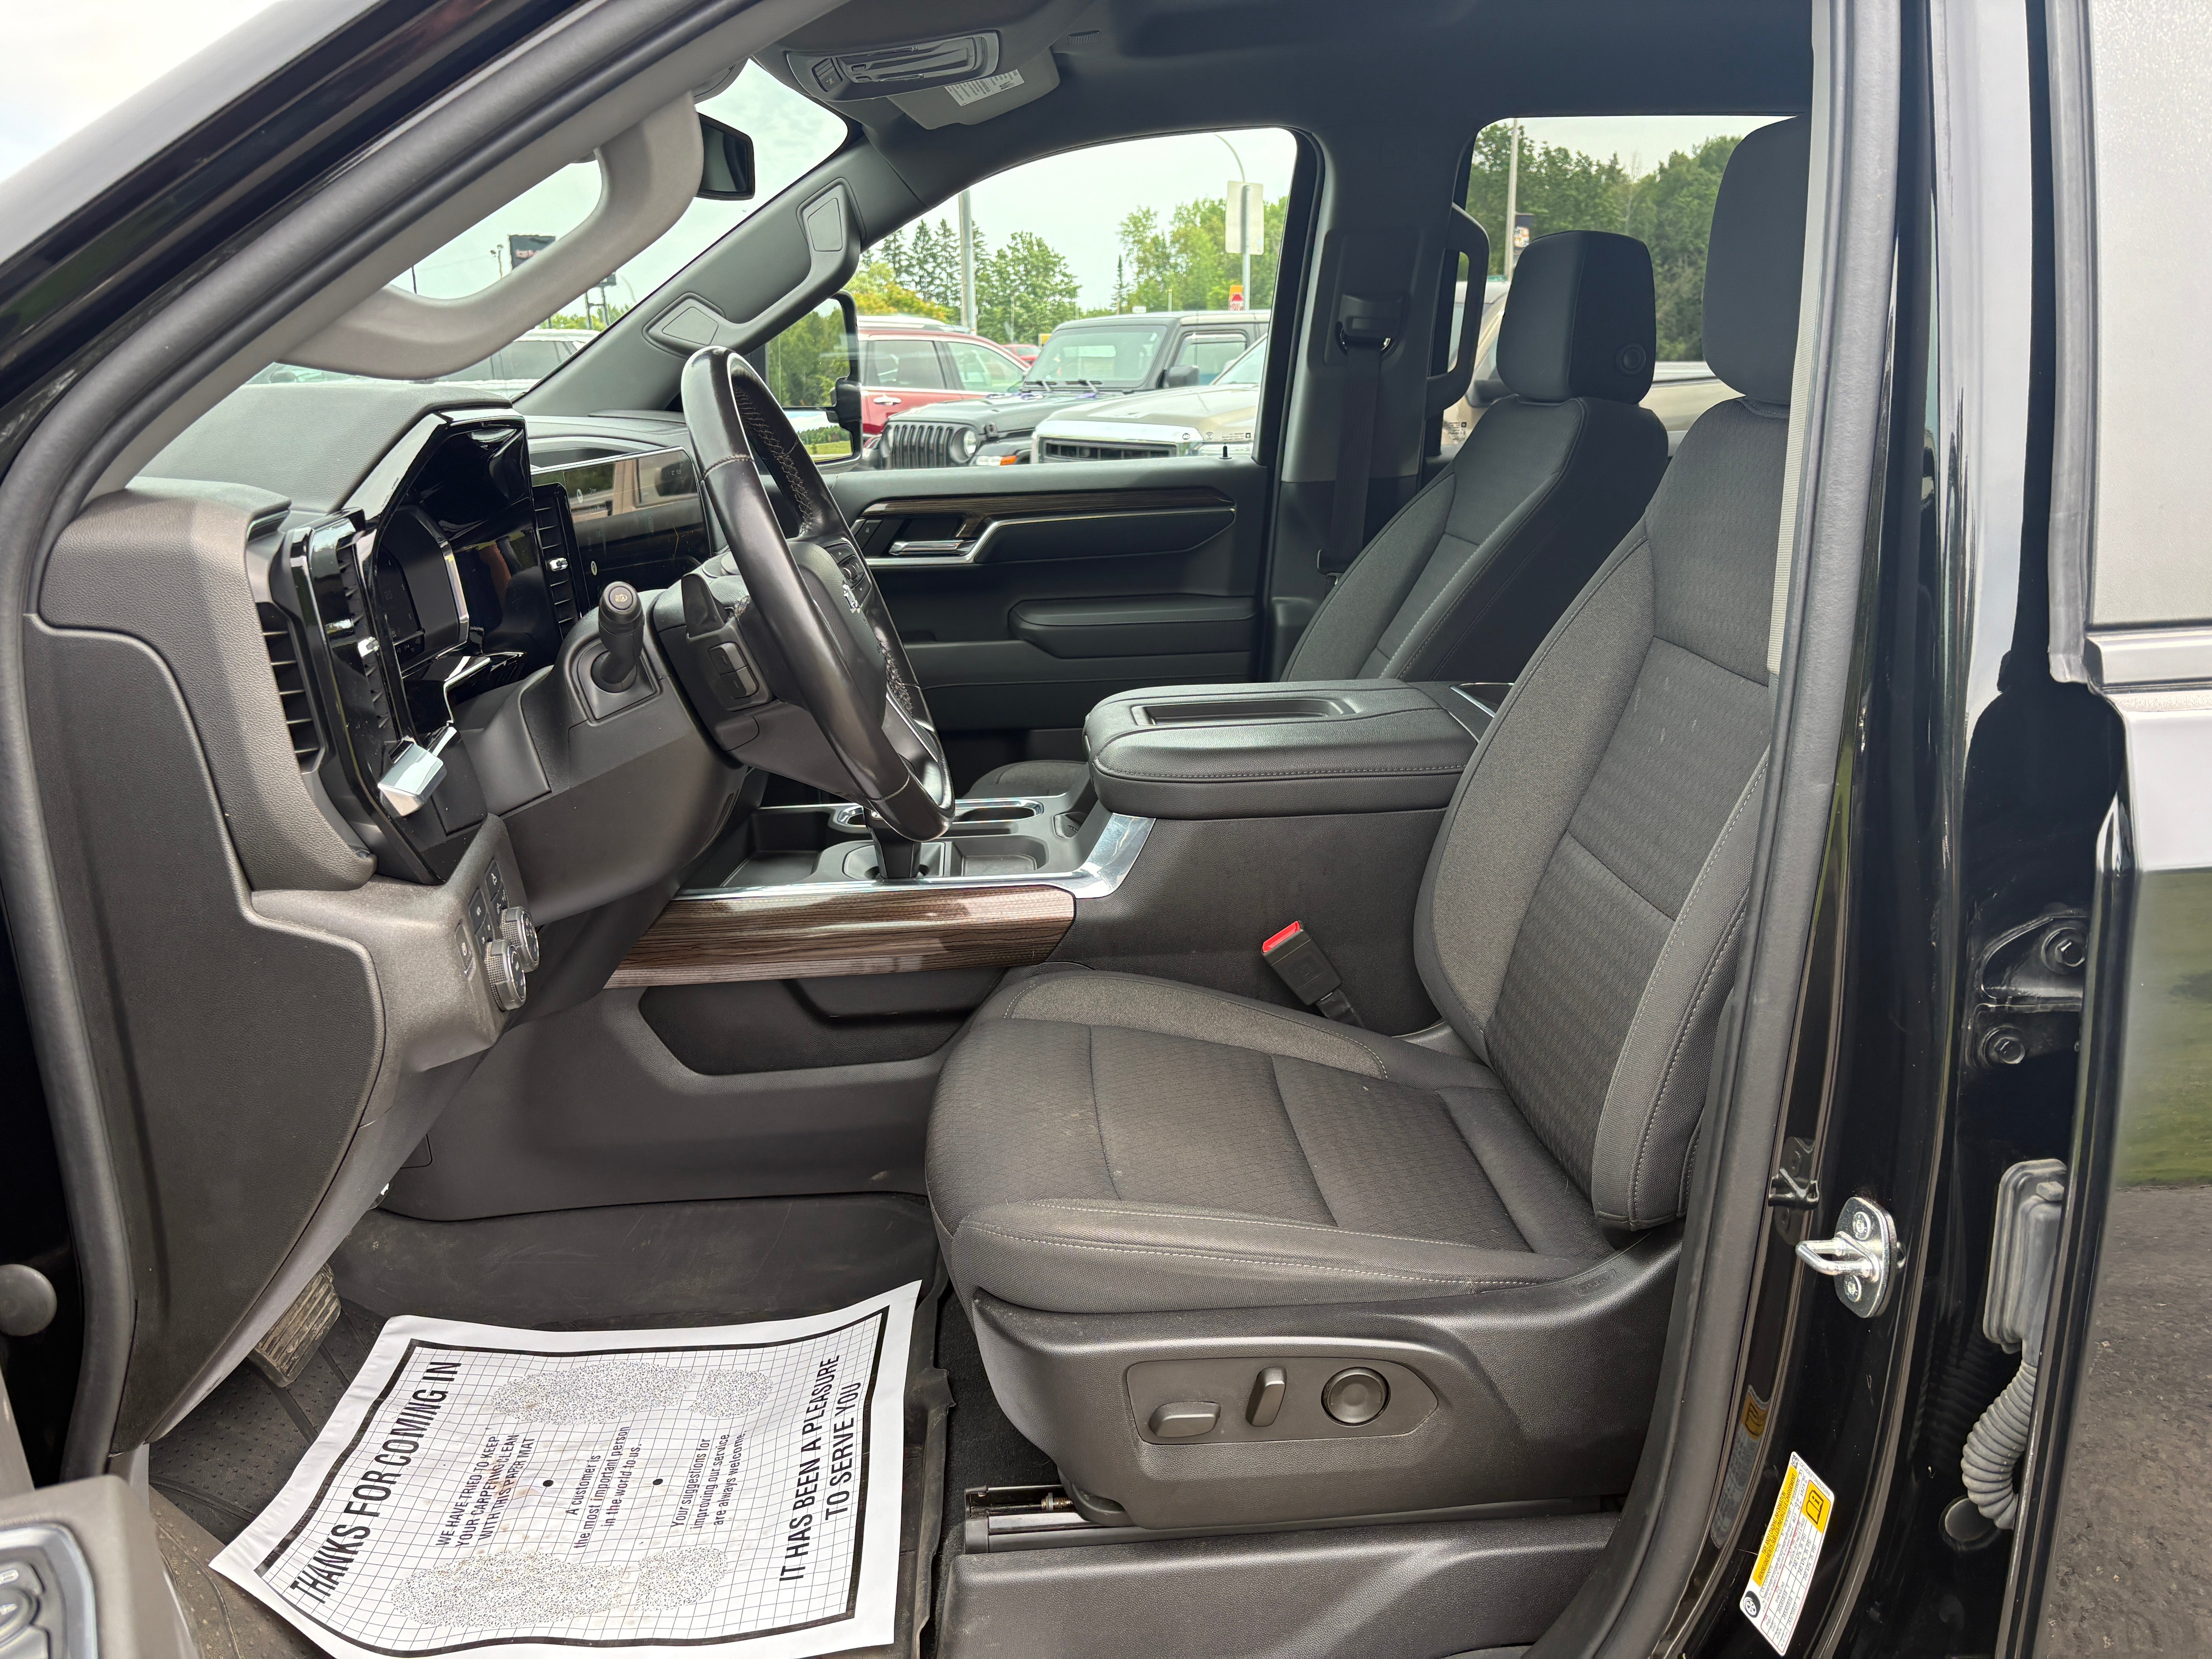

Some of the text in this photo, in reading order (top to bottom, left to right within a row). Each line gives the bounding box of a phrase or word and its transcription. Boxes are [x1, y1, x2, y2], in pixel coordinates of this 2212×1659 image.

[290, 1362, 462, 1604] THANKS FOR COMING IN
[436, 1436, 500, 1545] WE HAVE TRIED TO KEEP
[455, 1435, 519, 1547] YOUR CARPETING CLEAN
[478, 1438, 535, 1540] WITH THIS PAPER MAT
[572, 1465, 596, 1505] customer
[574, 1427, 629, 1548] the most important person
[615, 1471, 632, 1497] world
[629, 1444, 642, 1457] us.
[671, 1439, 710, 1527] Your suggestions for
[690, 1434, 730, 1529] improving our service
[714, 1430, 747, 1525] are always welcome.
[779, 1355, 840, 1581] IT HAS BEEN A PLEASURE
[826, 1382, 861, 1520] TO SERVE YOU
[601, 1518, 616, 1527] in
[606, 1499, 622, 1514] the
